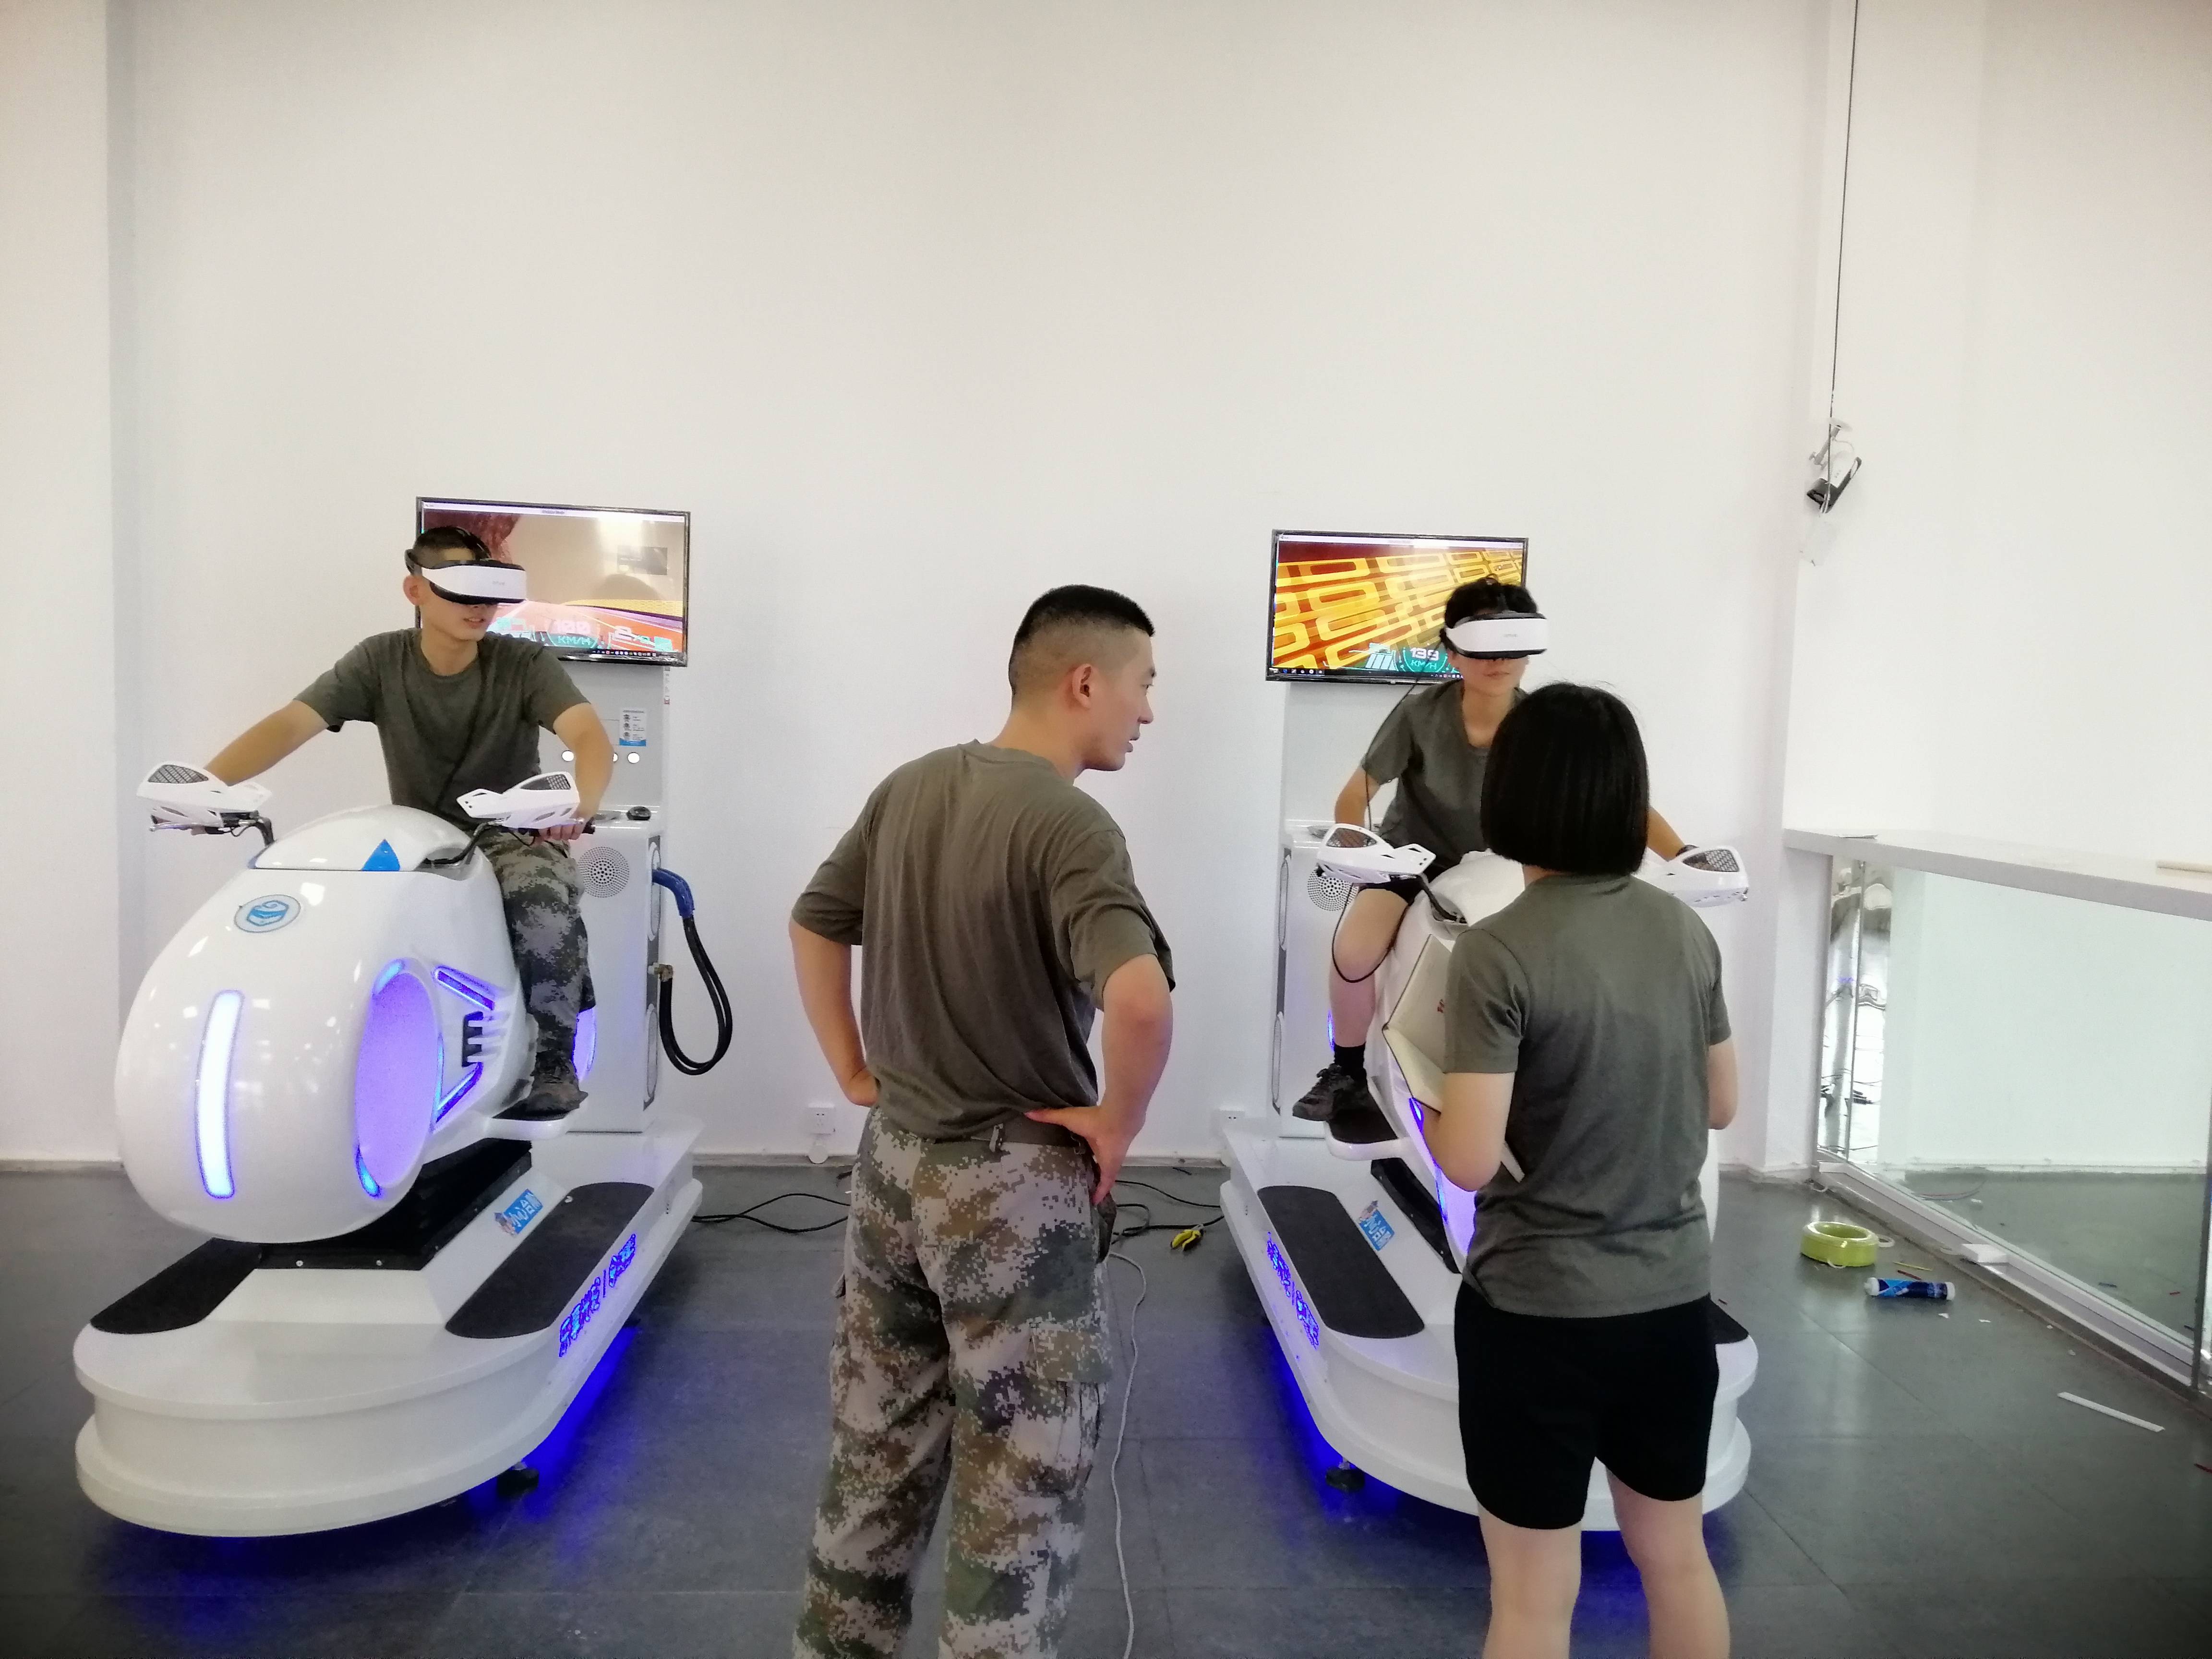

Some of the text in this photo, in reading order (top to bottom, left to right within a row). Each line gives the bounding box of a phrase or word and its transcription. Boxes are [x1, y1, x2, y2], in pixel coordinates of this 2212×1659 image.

[557, 635, 591, 646] KM/H
[1410, 647, 1439, 661] 139
[1410, 659, 1437, 670] KM/H
